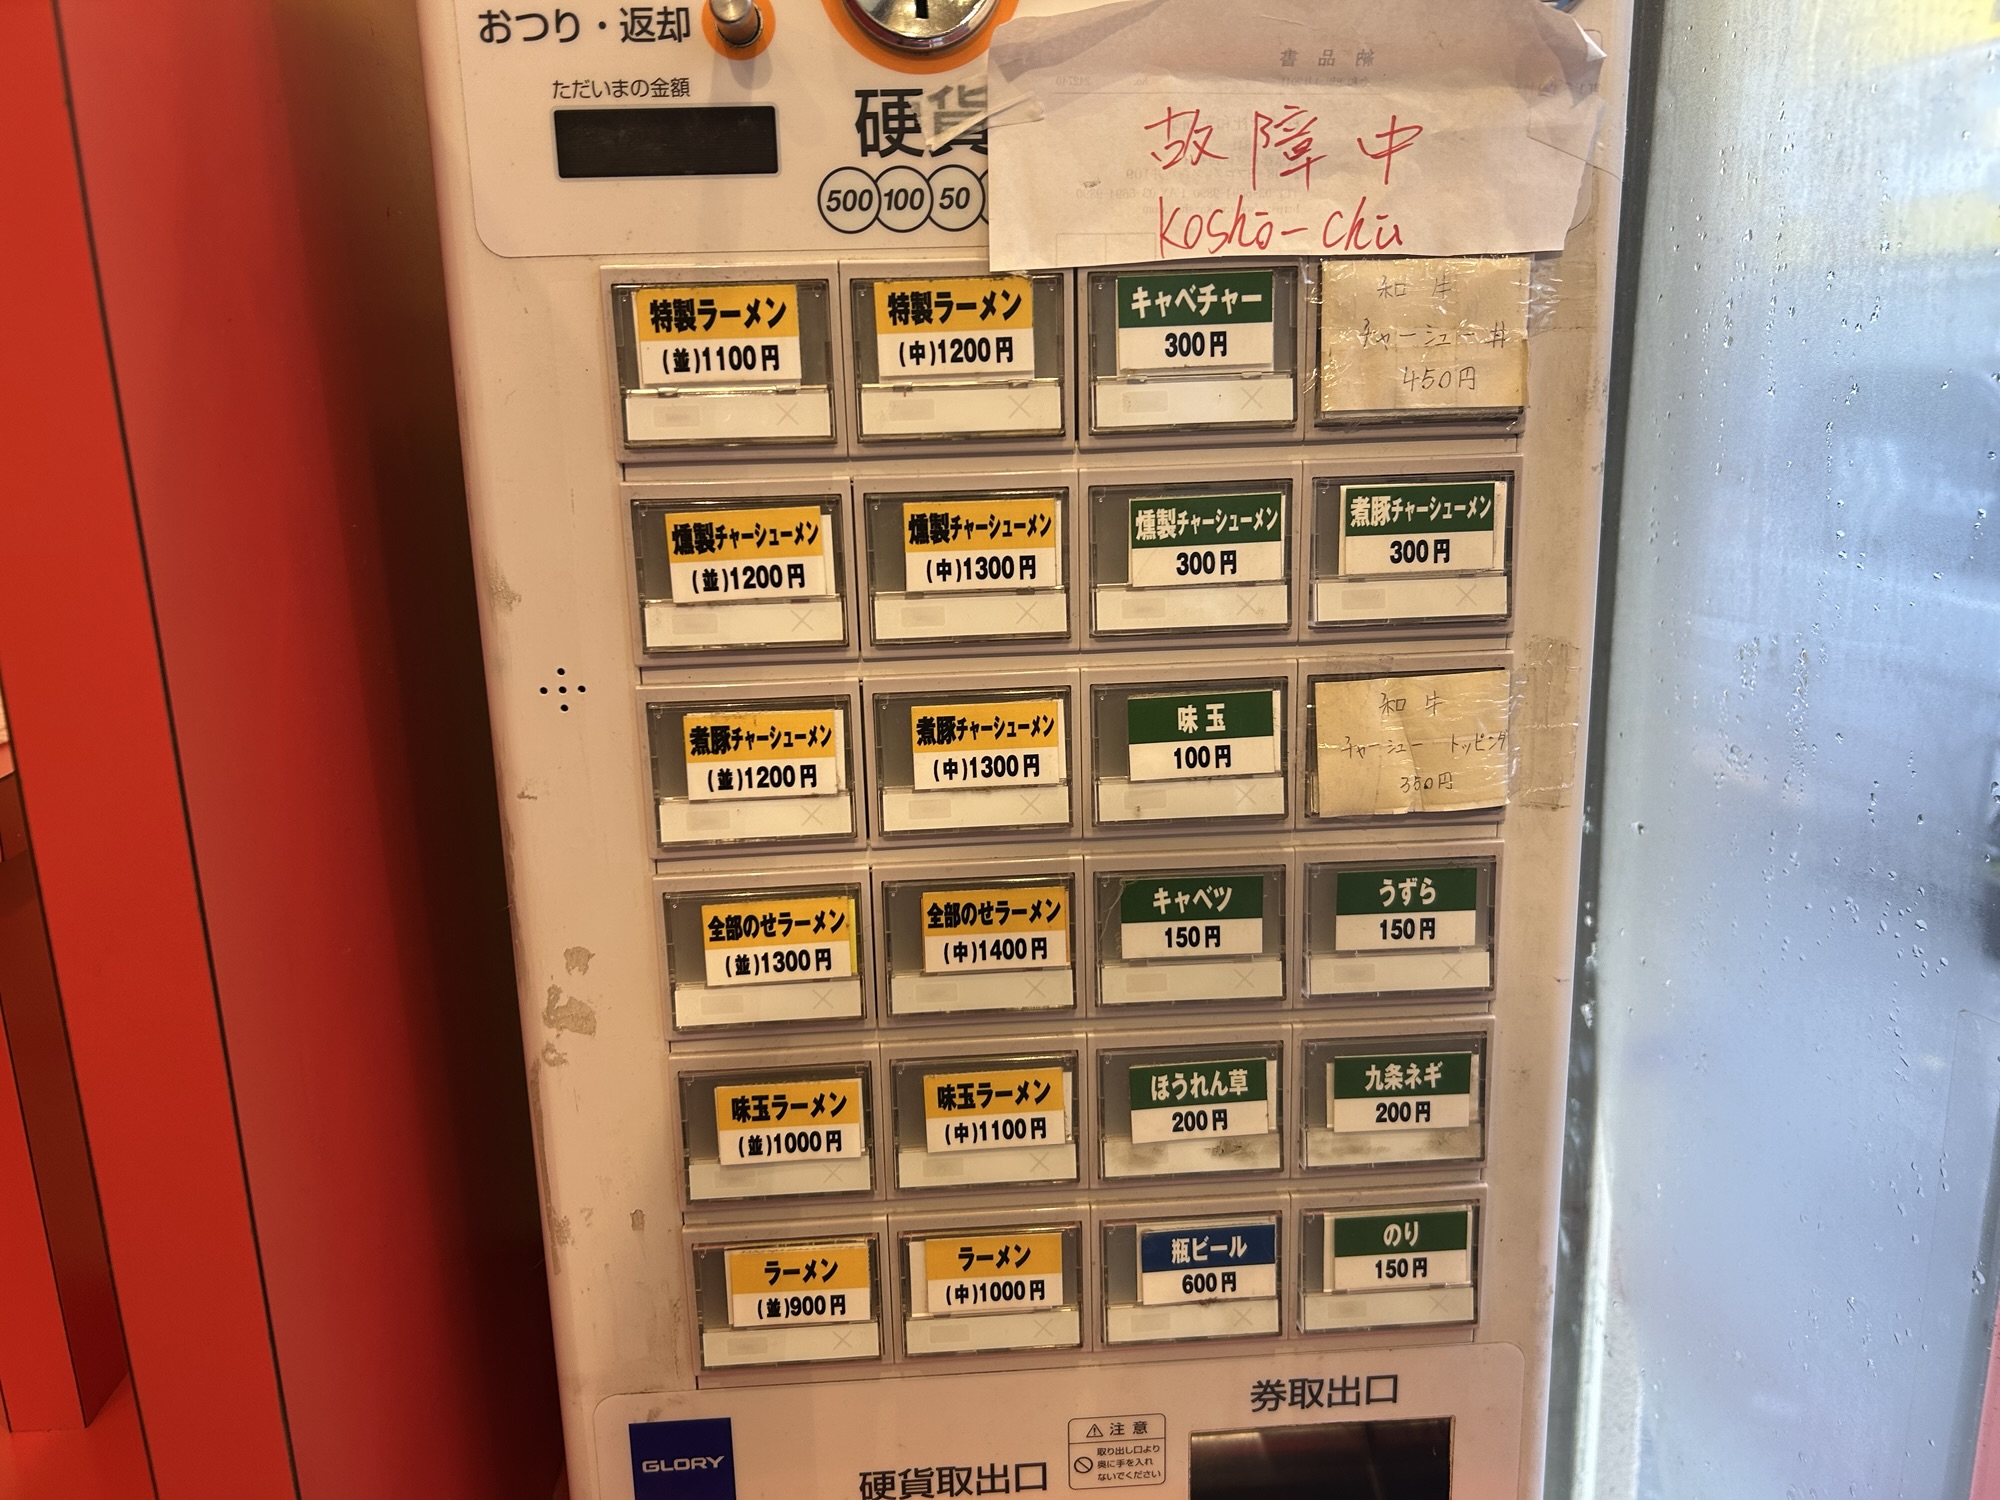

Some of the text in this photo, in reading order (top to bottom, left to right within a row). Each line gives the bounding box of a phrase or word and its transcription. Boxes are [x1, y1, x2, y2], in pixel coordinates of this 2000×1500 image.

[478, 6, 691, 45] おつり・返却
[552, 77, 690, 99] ただいまの金額
[1144, 105, 1423, 191] 故障中
[826, 187, 970, 212] 500 100 50
[649, 297, 787, 333] 特製ラーメン
[888, 290, 1022, 326] 特製ラーメン
[1130, 283, 1262, 319] キャベチャー
[899, 337, 1014, 367] (中)1200円
[1164, 331, 1228, 357] 300円
[663, 345, 780, 375] (並)1100円
[1403, 367, 1475, 392] 450円
[1350, 495, 1492, 528] 煮豚チャーシューメン
[1176, 550, 1237, 576] 300円
[1389, 538, 1450, 564] 300円
[692, 563, 806, 594] (並)1200円
[926, 555, 1037, 585] (中)1300円
[1379, 690, 1444, 716] 和牛
[916, 715, 1055, 745] 煮豚チャーシューメン
[1177, 703, 1226, 734] 味玉
[690, 724, 832, 756] 煮豚チャーシューメン
[933, 754, 1040, 782] (中)1300円
[1174, 745, 1232, 770] 100円
[707, 764, 817, 792] (並)1200円
[1401, 771, 1453, 793] 350円
[1153, 885, 1233, 915] キャベツ
[1379, 877, 1437, 907] うずら
[708, 909, 846, 943] 全部のせラーメン
[927, 898, 1061, 929] 全部のせラーメン
[1165, 925, 1221, 949] 150円
[1380, 917, 1435, 941] 150円
[725, 948, 832, 977] (並)1300円
[944, 936, 1048, 964] (中)1400円
[1151, 1069, 1248, 1101] ほうれん草
[1365, 1061, 1443, 1092] 九条ネギ
[731, 1092, 848, 1123] 味玉ラーメン
[937, 1079, 1051, 1111] 味玉ラーメン
[1172, 1109, 1228, 1133] 200円
[1375, 1101, 1431, 1124] 200円
[739, 1130, 842, 1157] (並)1000円
[945, 1117, 1047, 1145] (中)1100円
[1383, 1221, 1419, 1246] のり
[957, 1244, 1031, 1270] ラーメン
[1171, 1236, 1248, 1265] 瓶ビール
[764, 1258, 839, 1286] ラーメン
[1375, 1257, 1428, 1279] 150円
[946, 1279, 1045, 1305] (中)1000円
[1182, 1271, 1237, 1294] 600円
[757, 1294, 846, 1319] (並)900円
[1250, 1375, 1398, 1412] 券取出口
[1109, 1420, 1148, 1436] 注意
[641, 1455, 725, 1473] GLORY
[1097, 1445, 1160, 1456] 取り出し口より
[1097, 1458, 1153, 1469] 奥に手を入れ
[859, 1462, 1047, 1500] 硬貨取出口
[1097, 1470, 1161, 1481] ないでください
